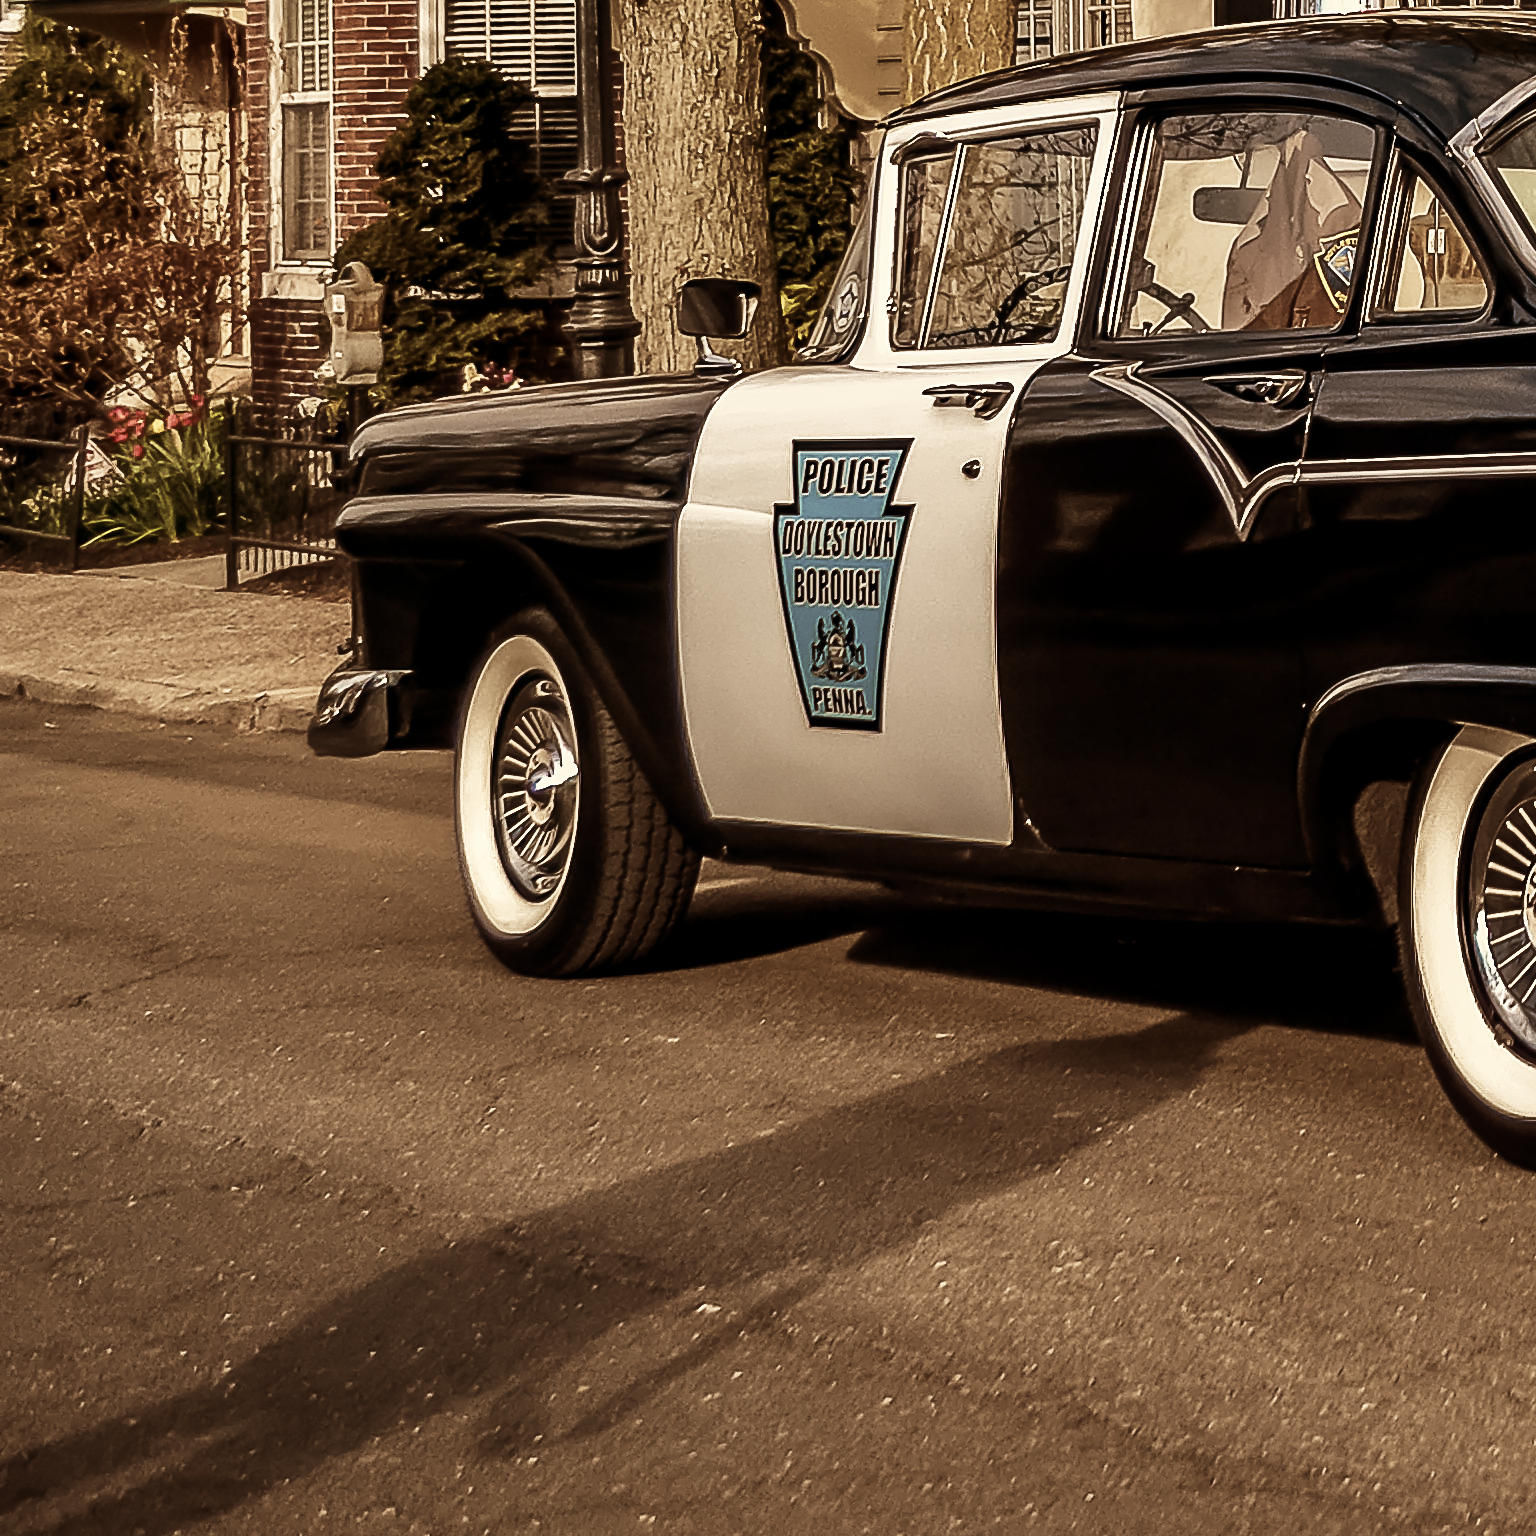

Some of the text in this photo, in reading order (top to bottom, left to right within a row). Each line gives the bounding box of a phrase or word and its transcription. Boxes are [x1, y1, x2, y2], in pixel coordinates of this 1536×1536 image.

[801, 457, 890, 496] POLICE
[782, 520, 897, 559] DOYLESTOWN
[793, 567, 881, 607] BOROUGH
[811, 687, 873, 716] PENNA.
